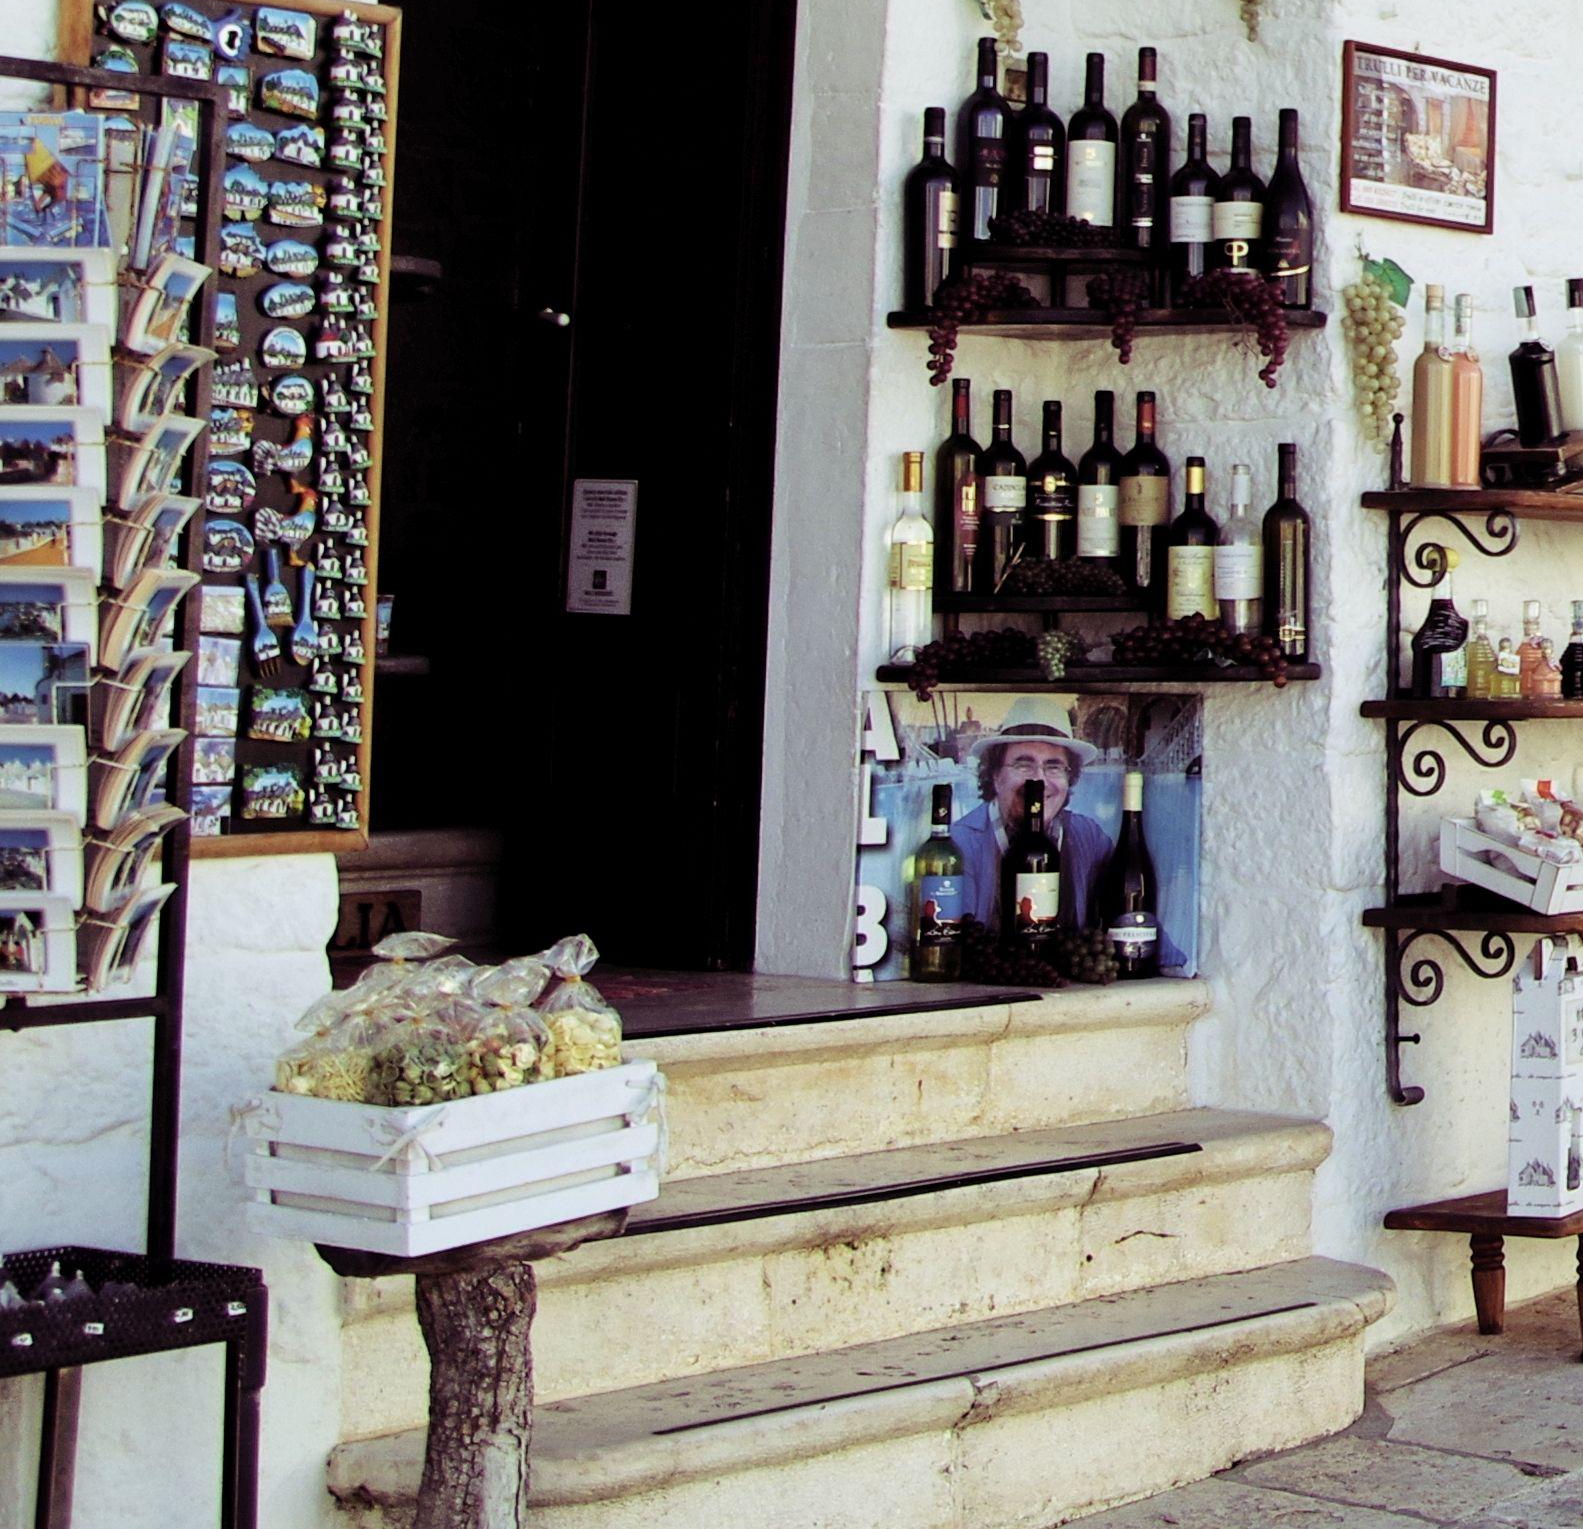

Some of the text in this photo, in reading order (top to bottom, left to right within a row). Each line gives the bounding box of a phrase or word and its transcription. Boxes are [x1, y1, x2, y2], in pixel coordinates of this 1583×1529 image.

[1357, 56, 1487, 96] TRULLI PER VACANZE
